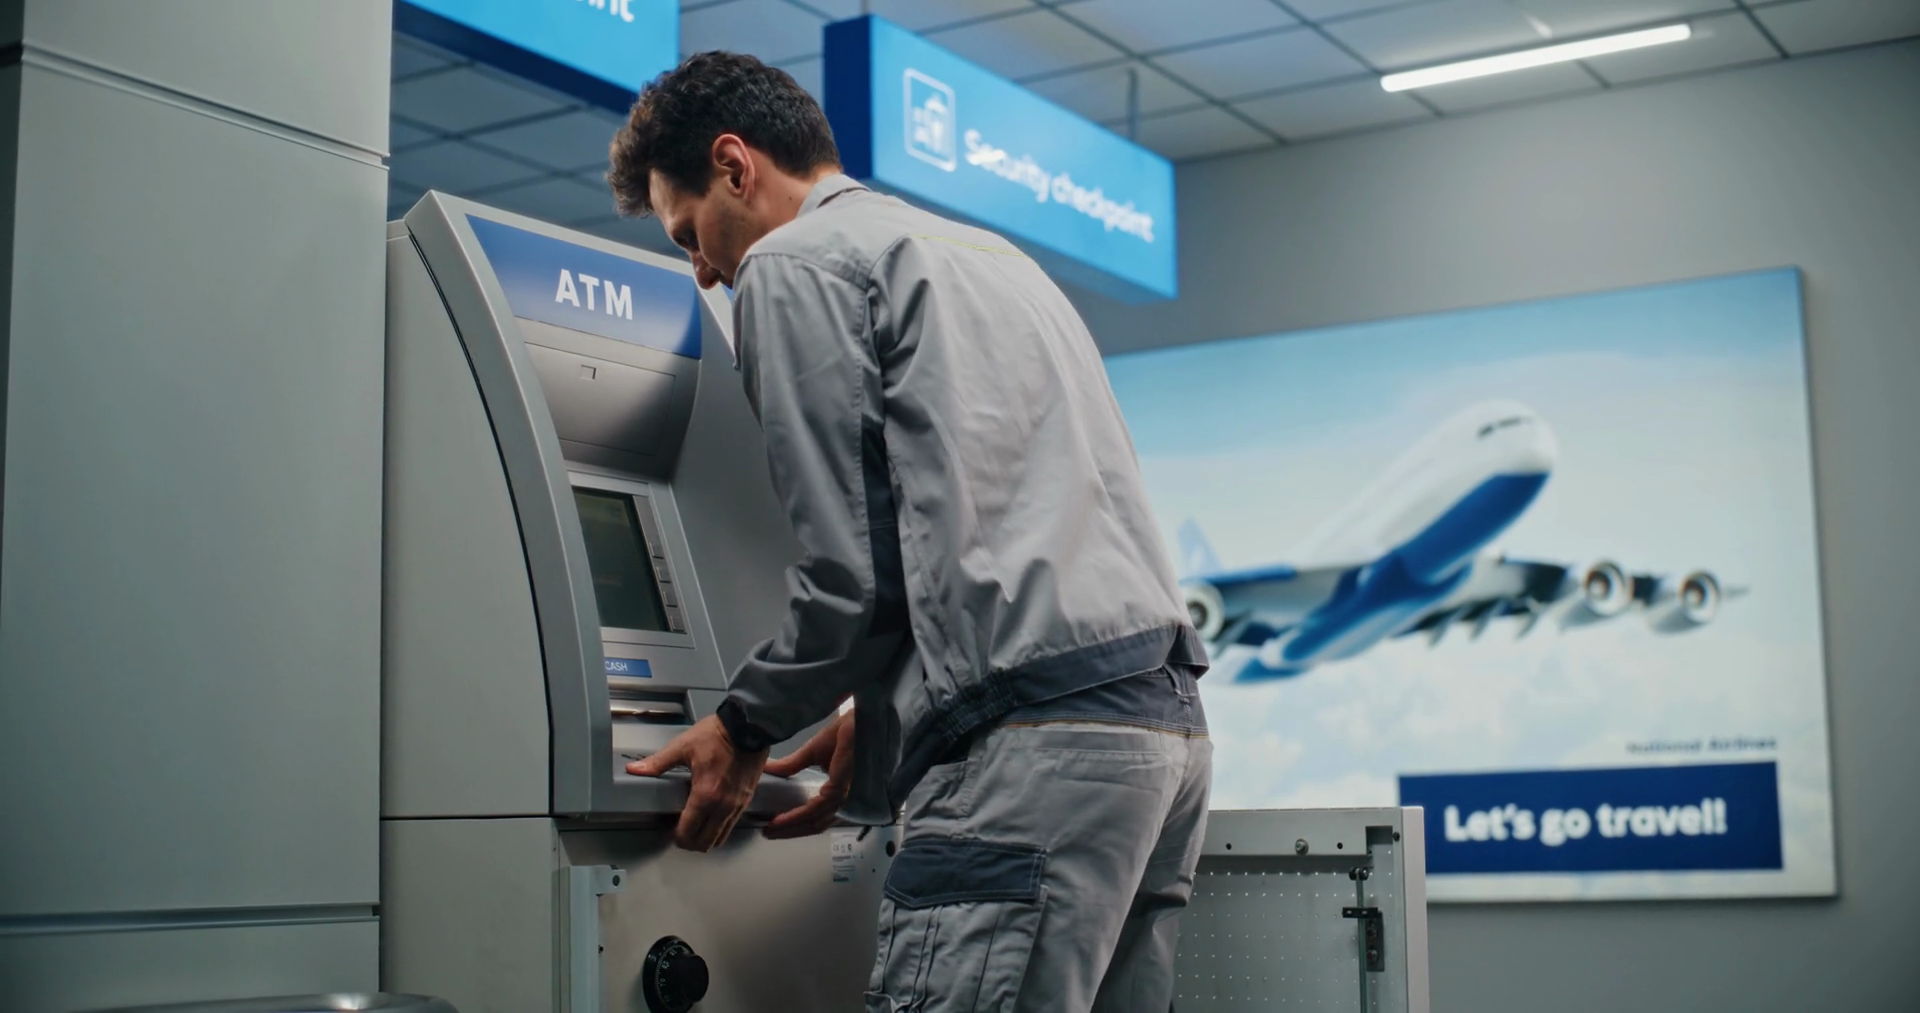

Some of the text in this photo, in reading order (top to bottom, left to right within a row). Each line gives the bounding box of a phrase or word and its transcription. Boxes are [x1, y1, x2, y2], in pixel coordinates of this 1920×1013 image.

[964, 128, 1154, 243] Security checkpoint
[555, 268, 634, 321] ATM
[605, 660, 628, 672] CASH
[1540, 808, 1592, 847] go
[1596, 797, 1729, 839] travel!
